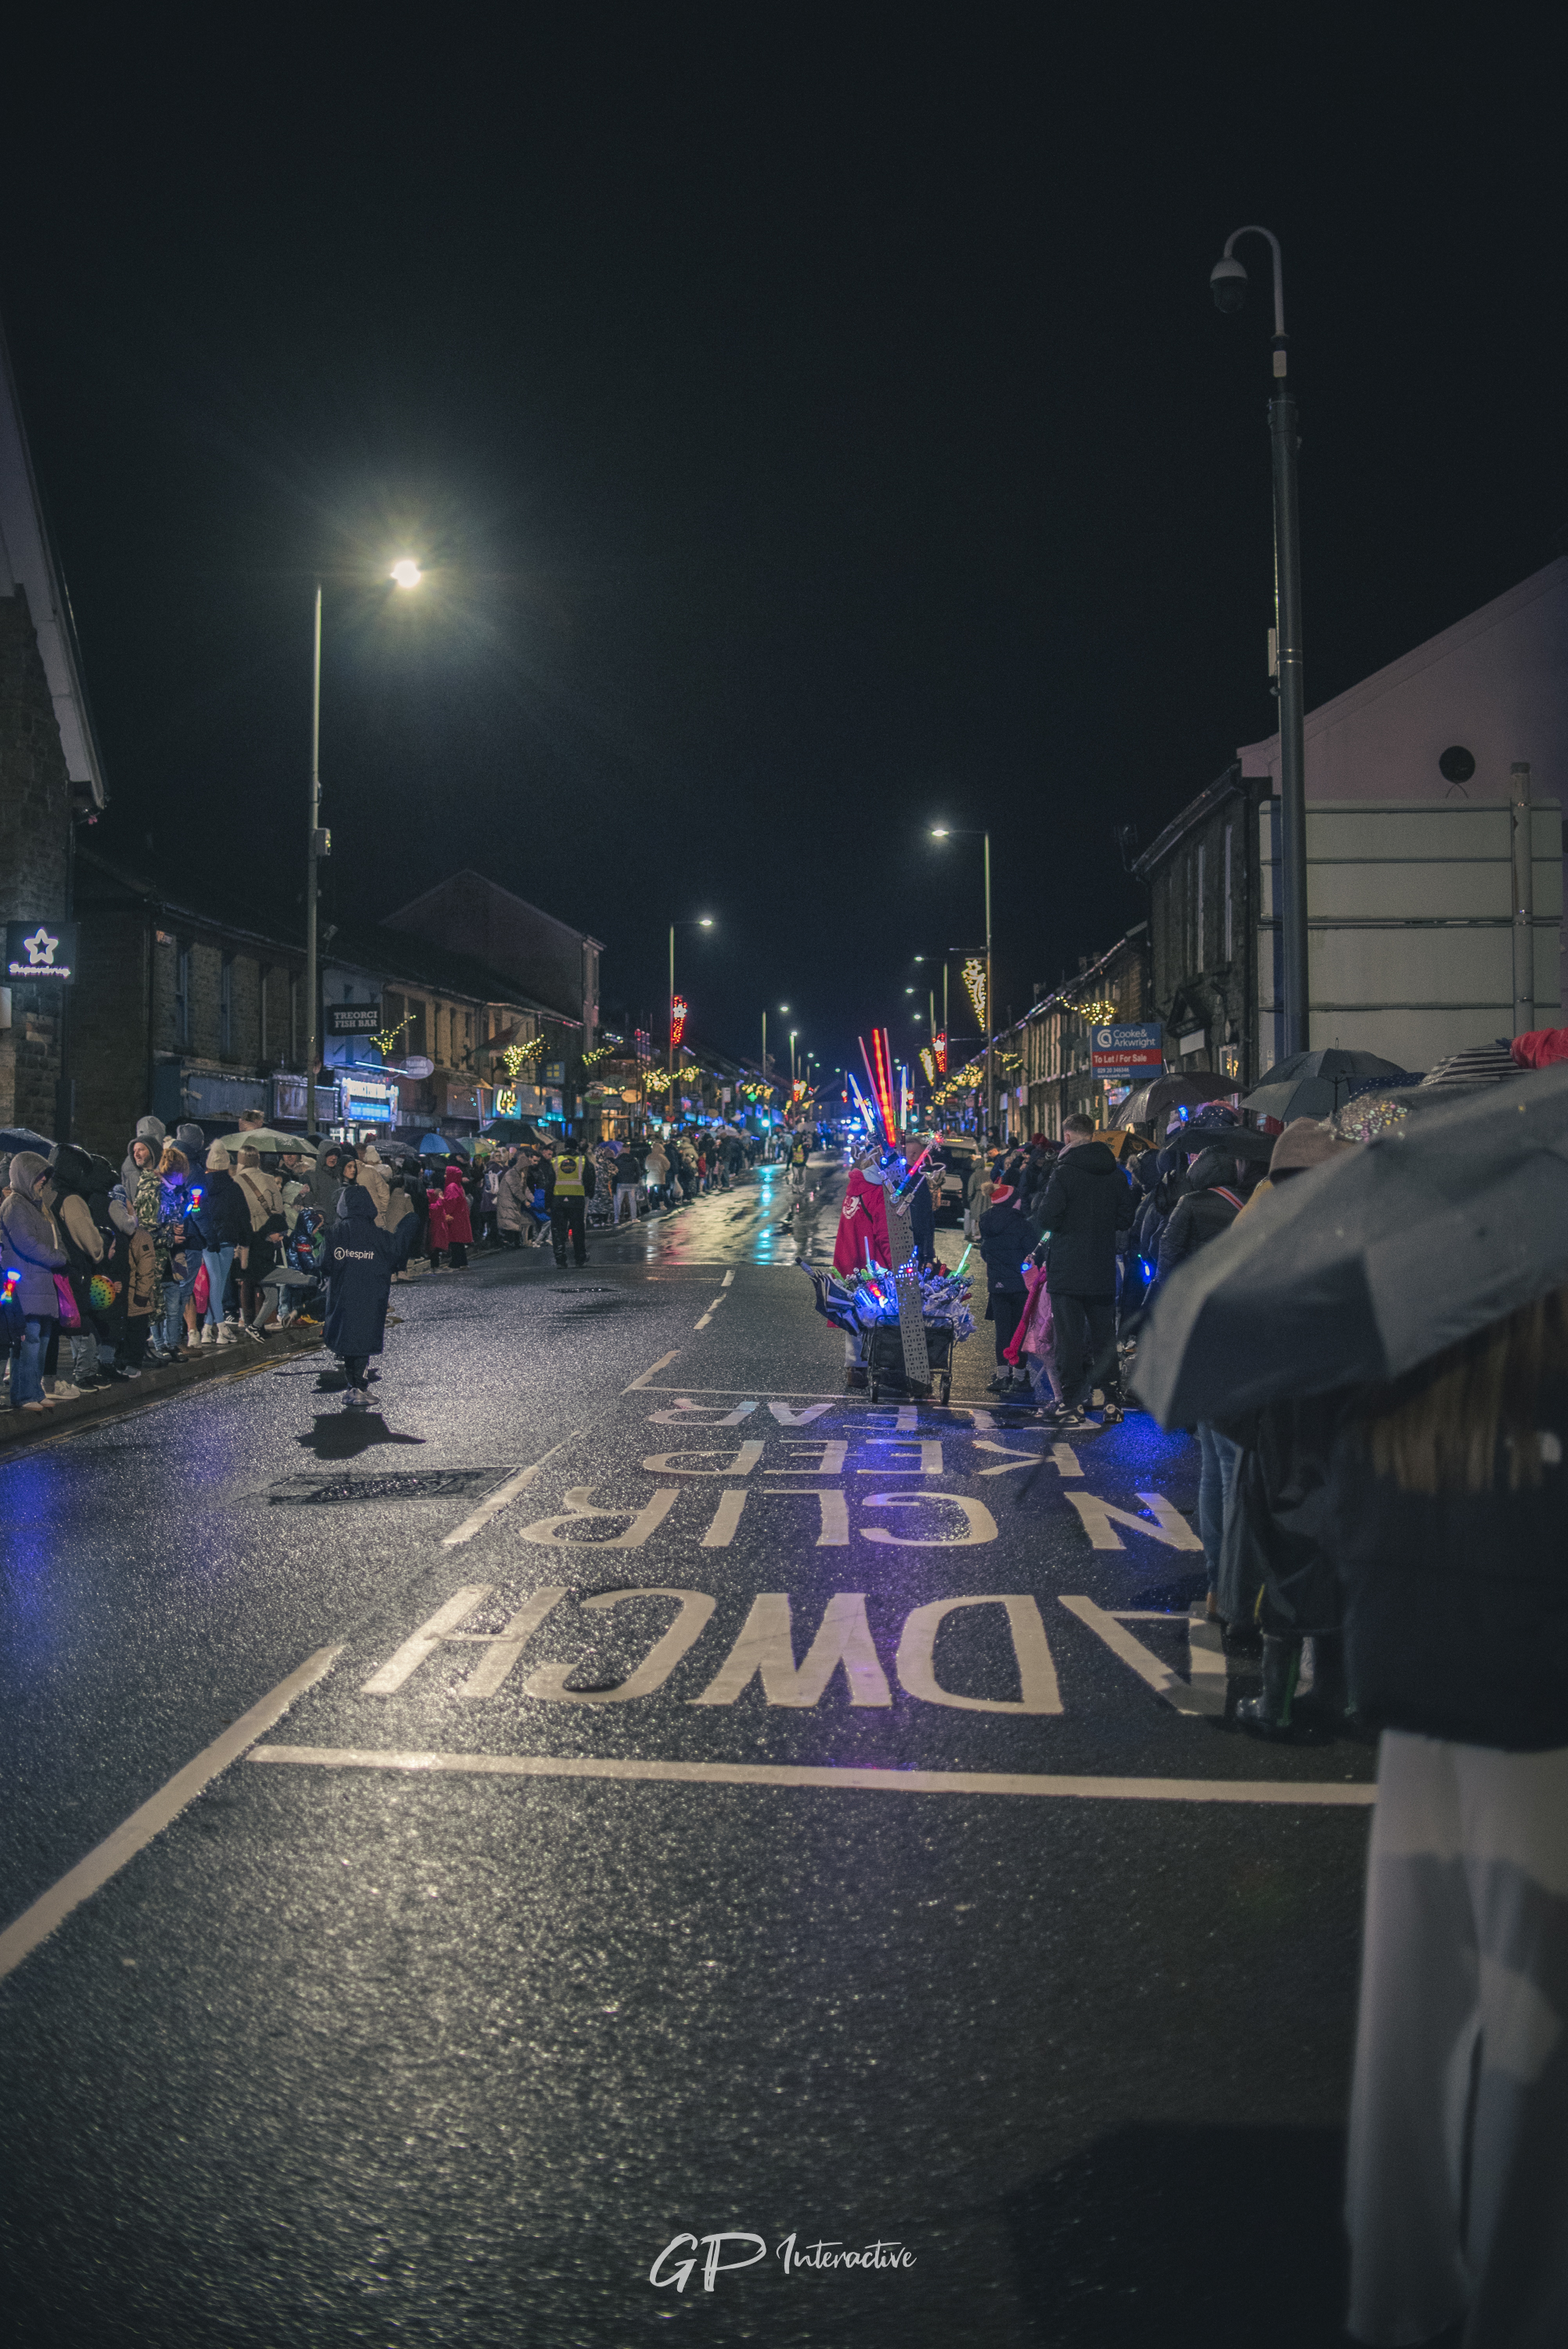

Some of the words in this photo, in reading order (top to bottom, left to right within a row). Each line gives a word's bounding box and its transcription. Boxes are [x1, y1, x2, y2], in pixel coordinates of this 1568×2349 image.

[334, 1011, 378, 1019] TREORCI
[334, 1019, 356, 1028] FISH
[1114, 1038, 1156, 1048] Arkwright
[1094, 1055, 1103, 1063] To
[1104, 1055, 1115, 1063] Let
[1119, 1054, 1131, 1063] For
[1132, 1053, 1148, 1063] Sale
[643, 1440, 1085, 1477] KEEP
[519, 1488, 998, 1548] GLIR
[360, 1583, 1314, 1716] ADWCH
